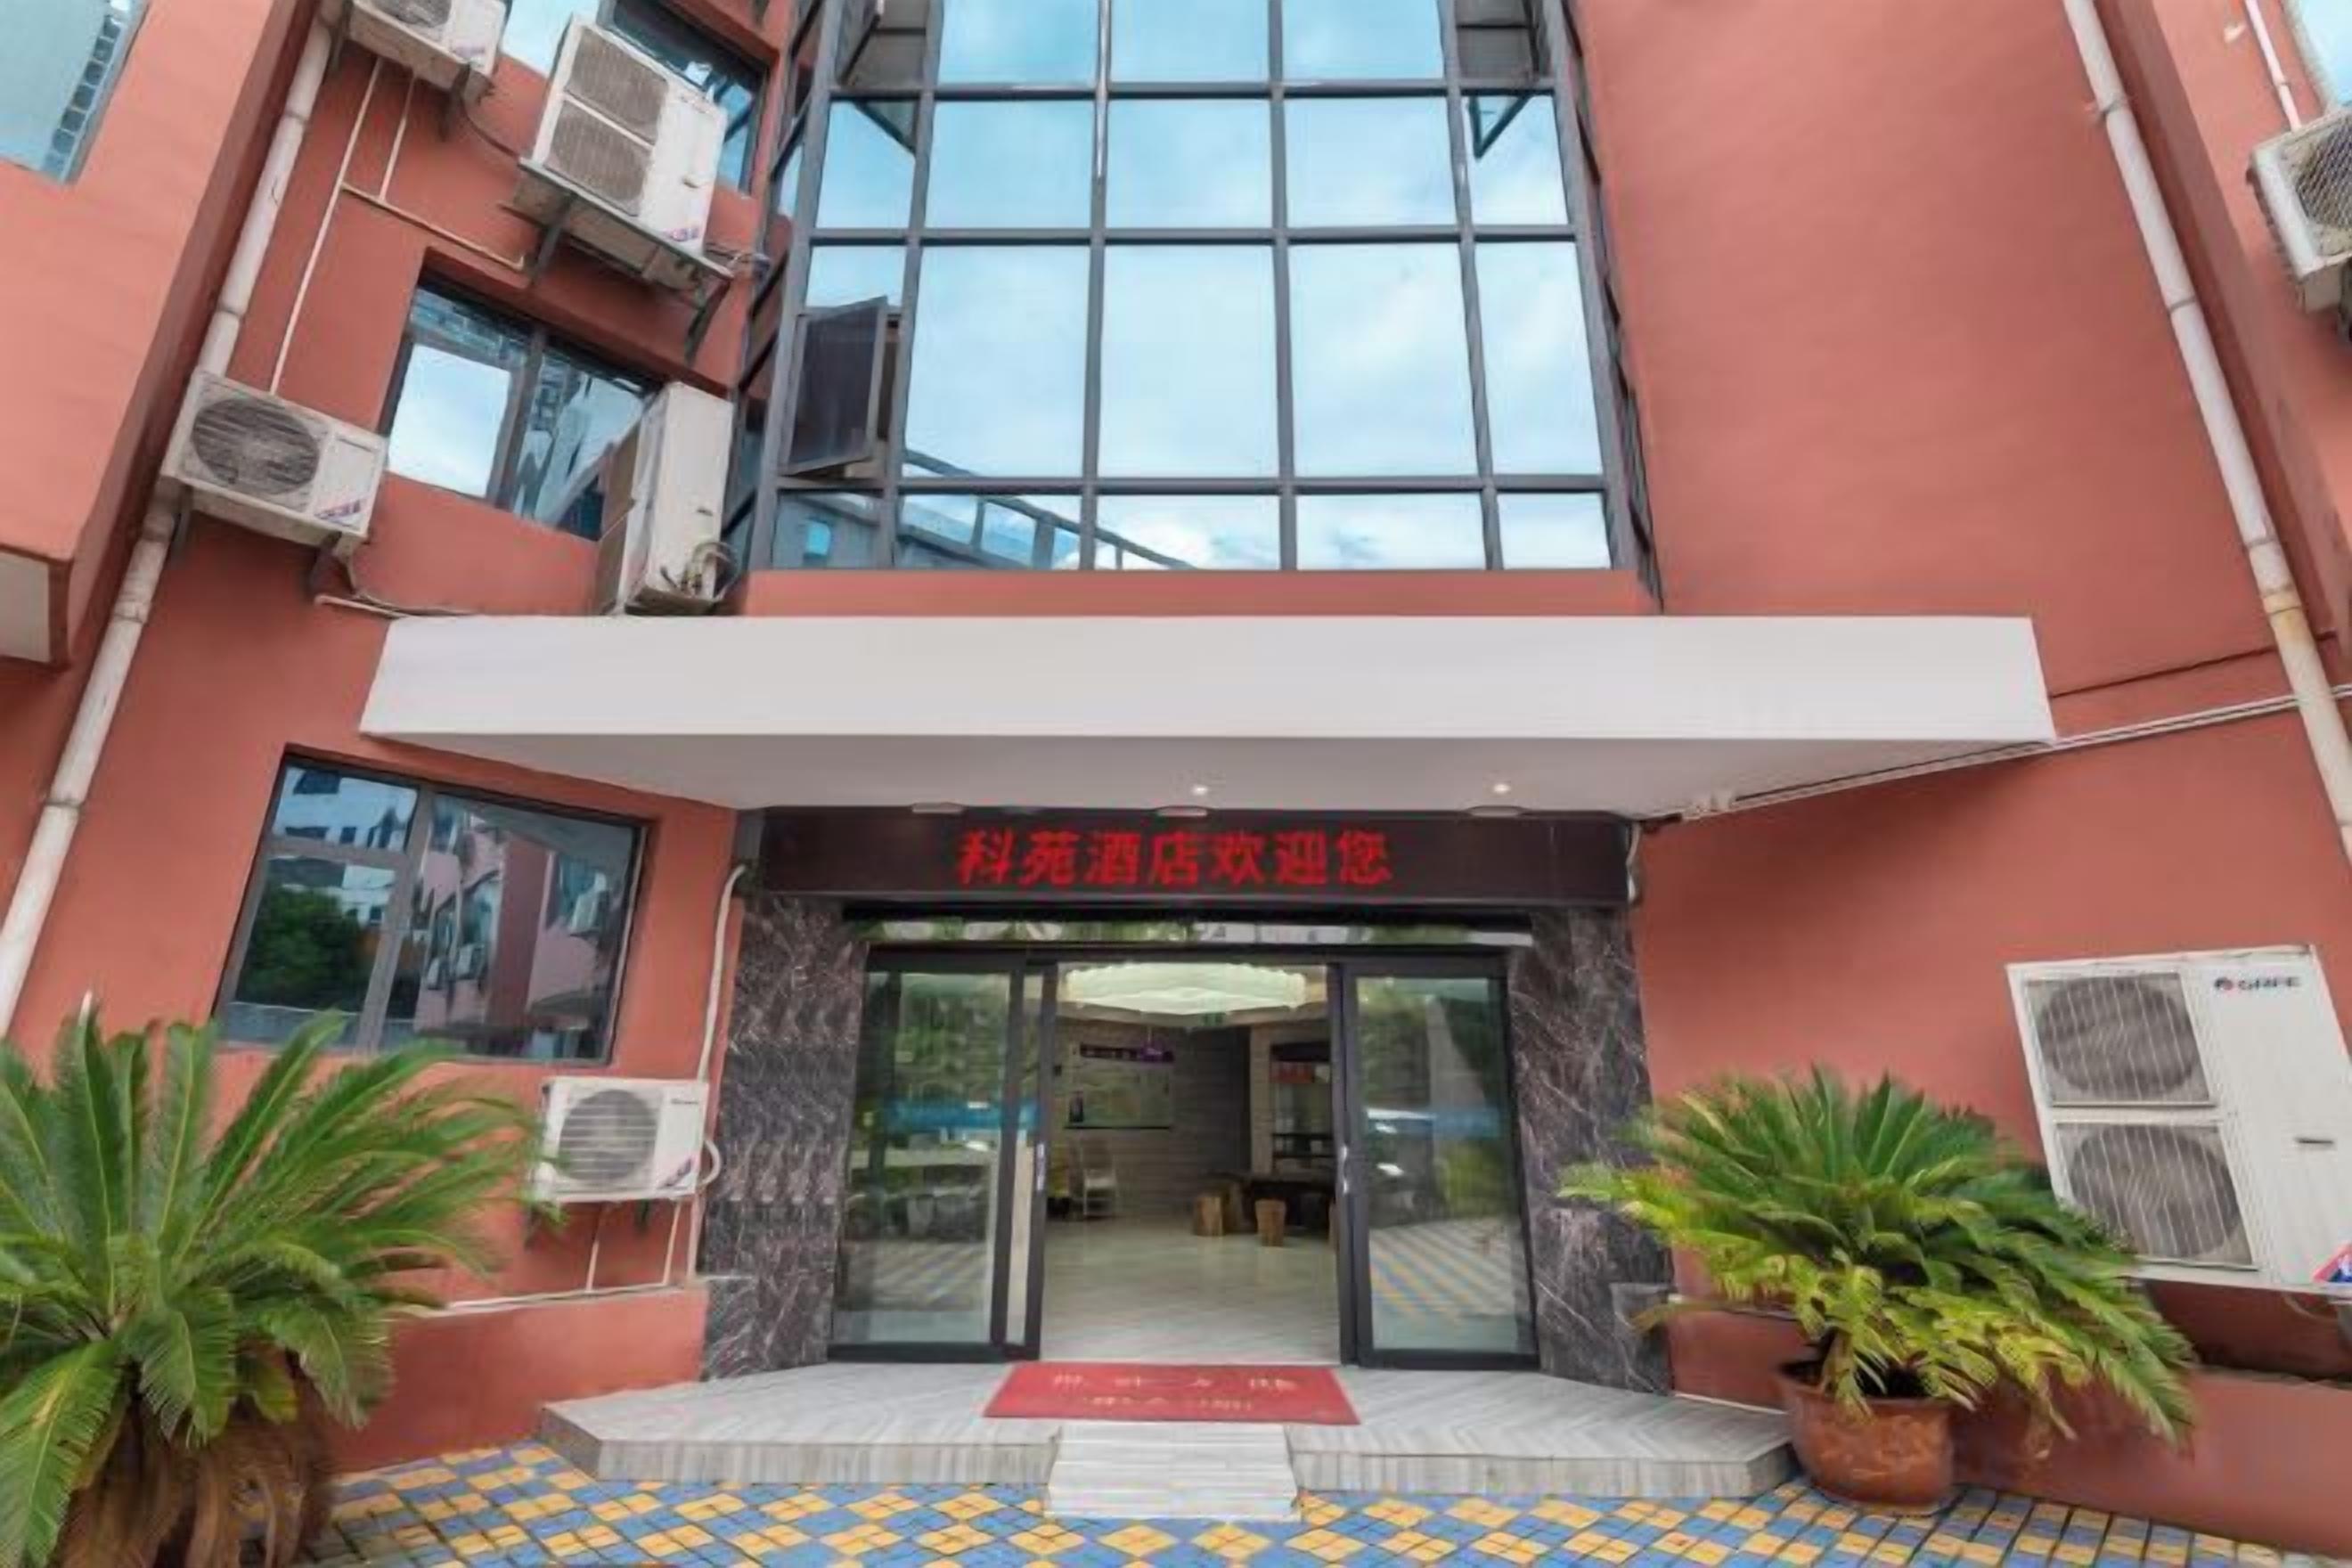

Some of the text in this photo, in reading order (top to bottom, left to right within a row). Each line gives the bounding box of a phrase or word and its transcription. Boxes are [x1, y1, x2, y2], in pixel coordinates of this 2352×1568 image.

[957, 829, 1392, 886] 科苑酒店欢迎您
